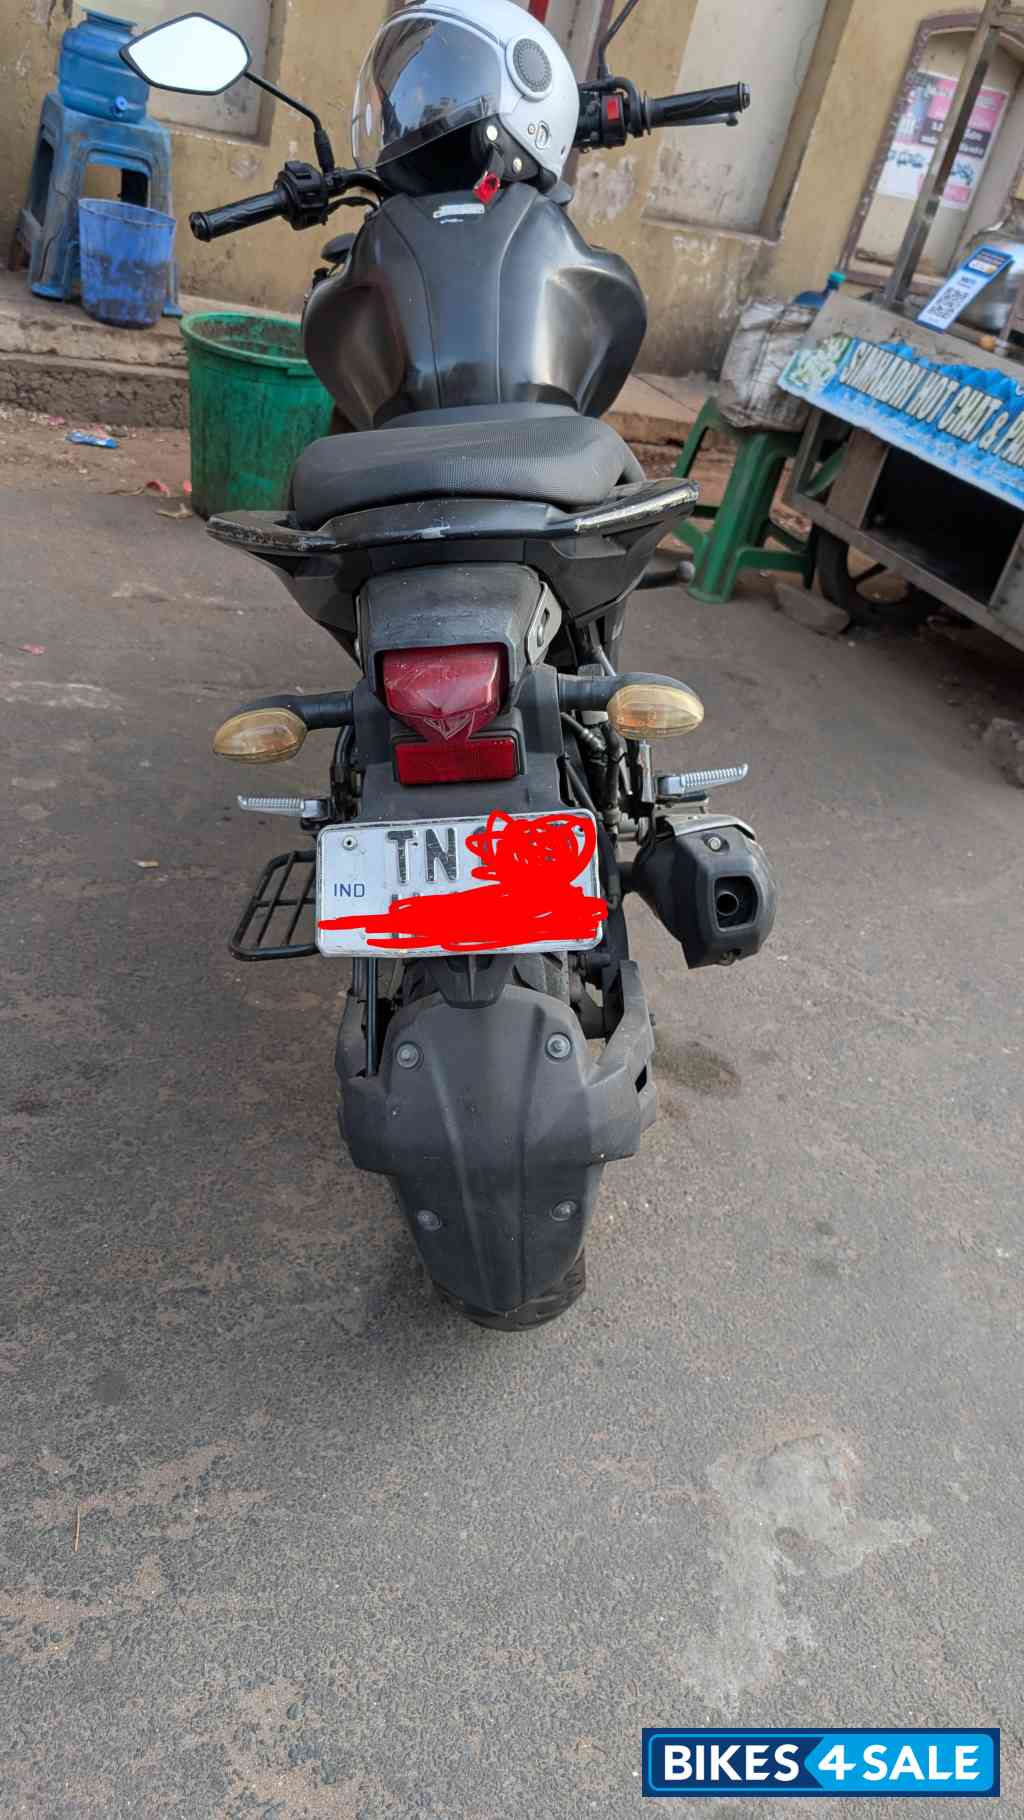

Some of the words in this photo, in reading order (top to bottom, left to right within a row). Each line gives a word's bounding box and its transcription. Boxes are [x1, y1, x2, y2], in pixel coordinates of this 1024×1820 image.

[906, 371, 960, 422] HOT
[938, 386, 1002, 441] CHAT
[979, 411, 1009, 449] &
[387, 828, 458, 883] TN
[333, 883, 366, 898] IND
